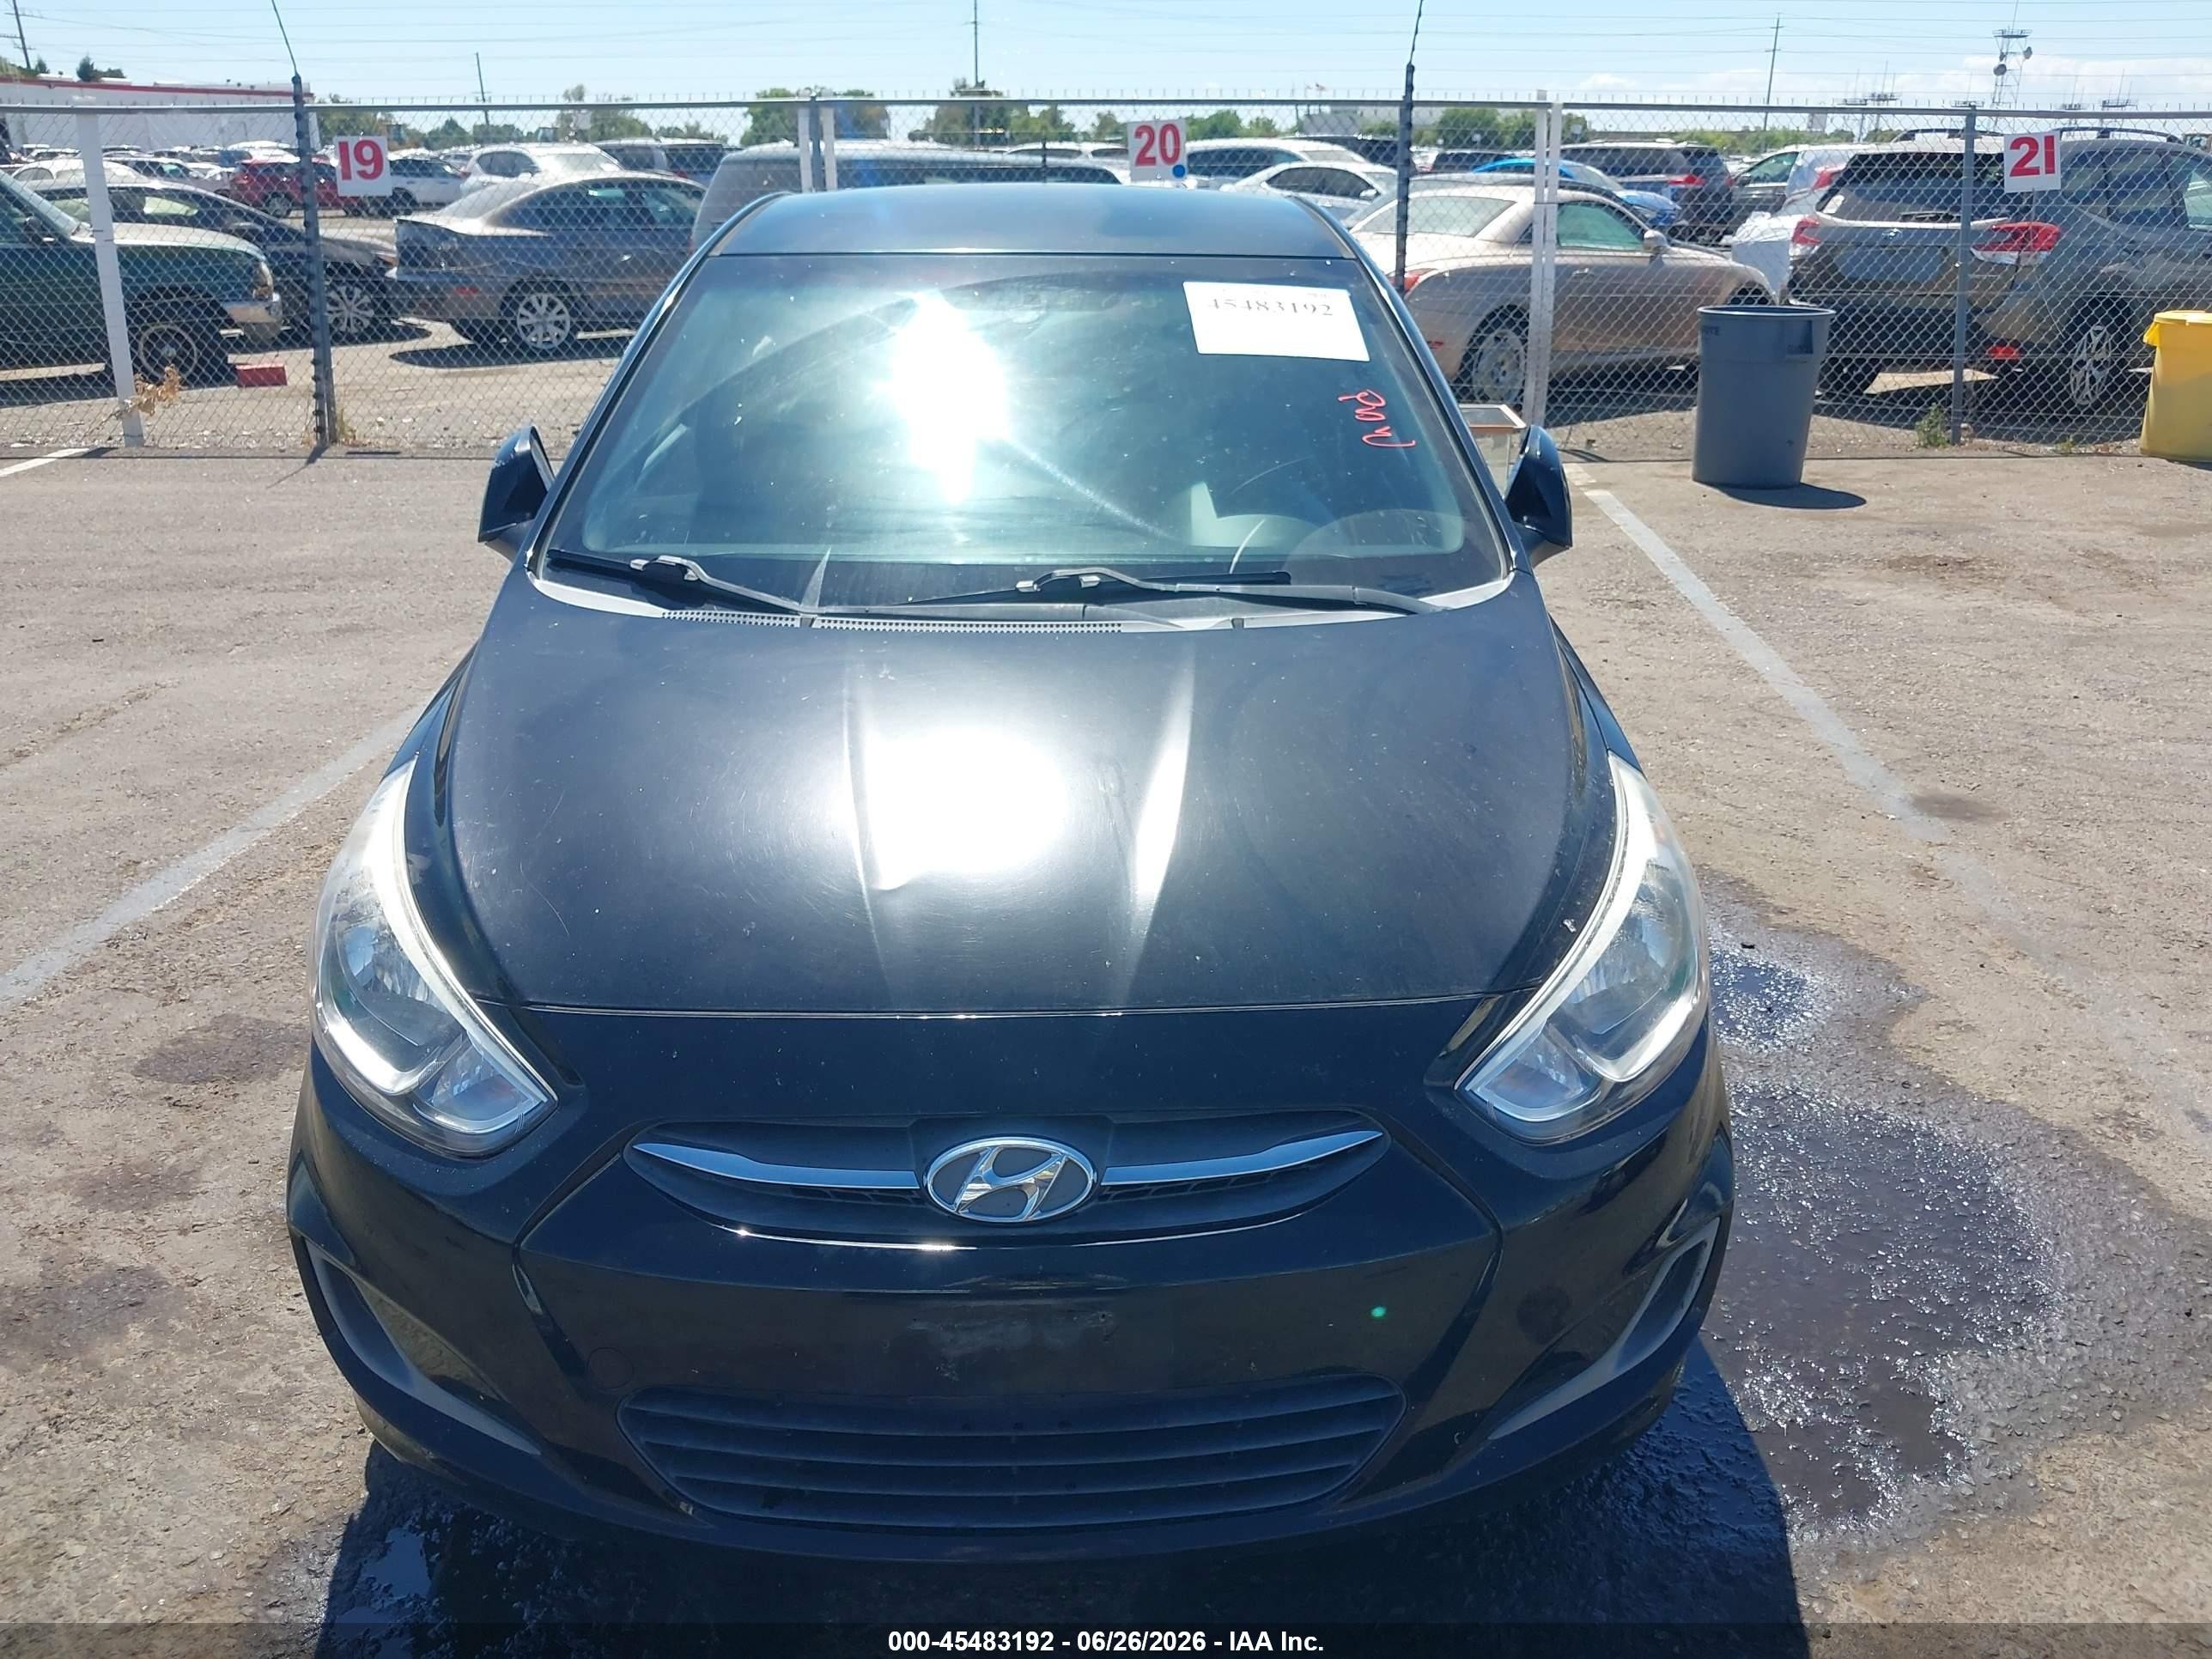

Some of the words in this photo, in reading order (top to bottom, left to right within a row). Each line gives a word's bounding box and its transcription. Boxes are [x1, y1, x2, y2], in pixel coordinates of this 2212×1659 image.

[338, 139, 383, 180] 19
[1135, 124, 1180, 166] 20
[2010, 136, 2056, 177] 21
